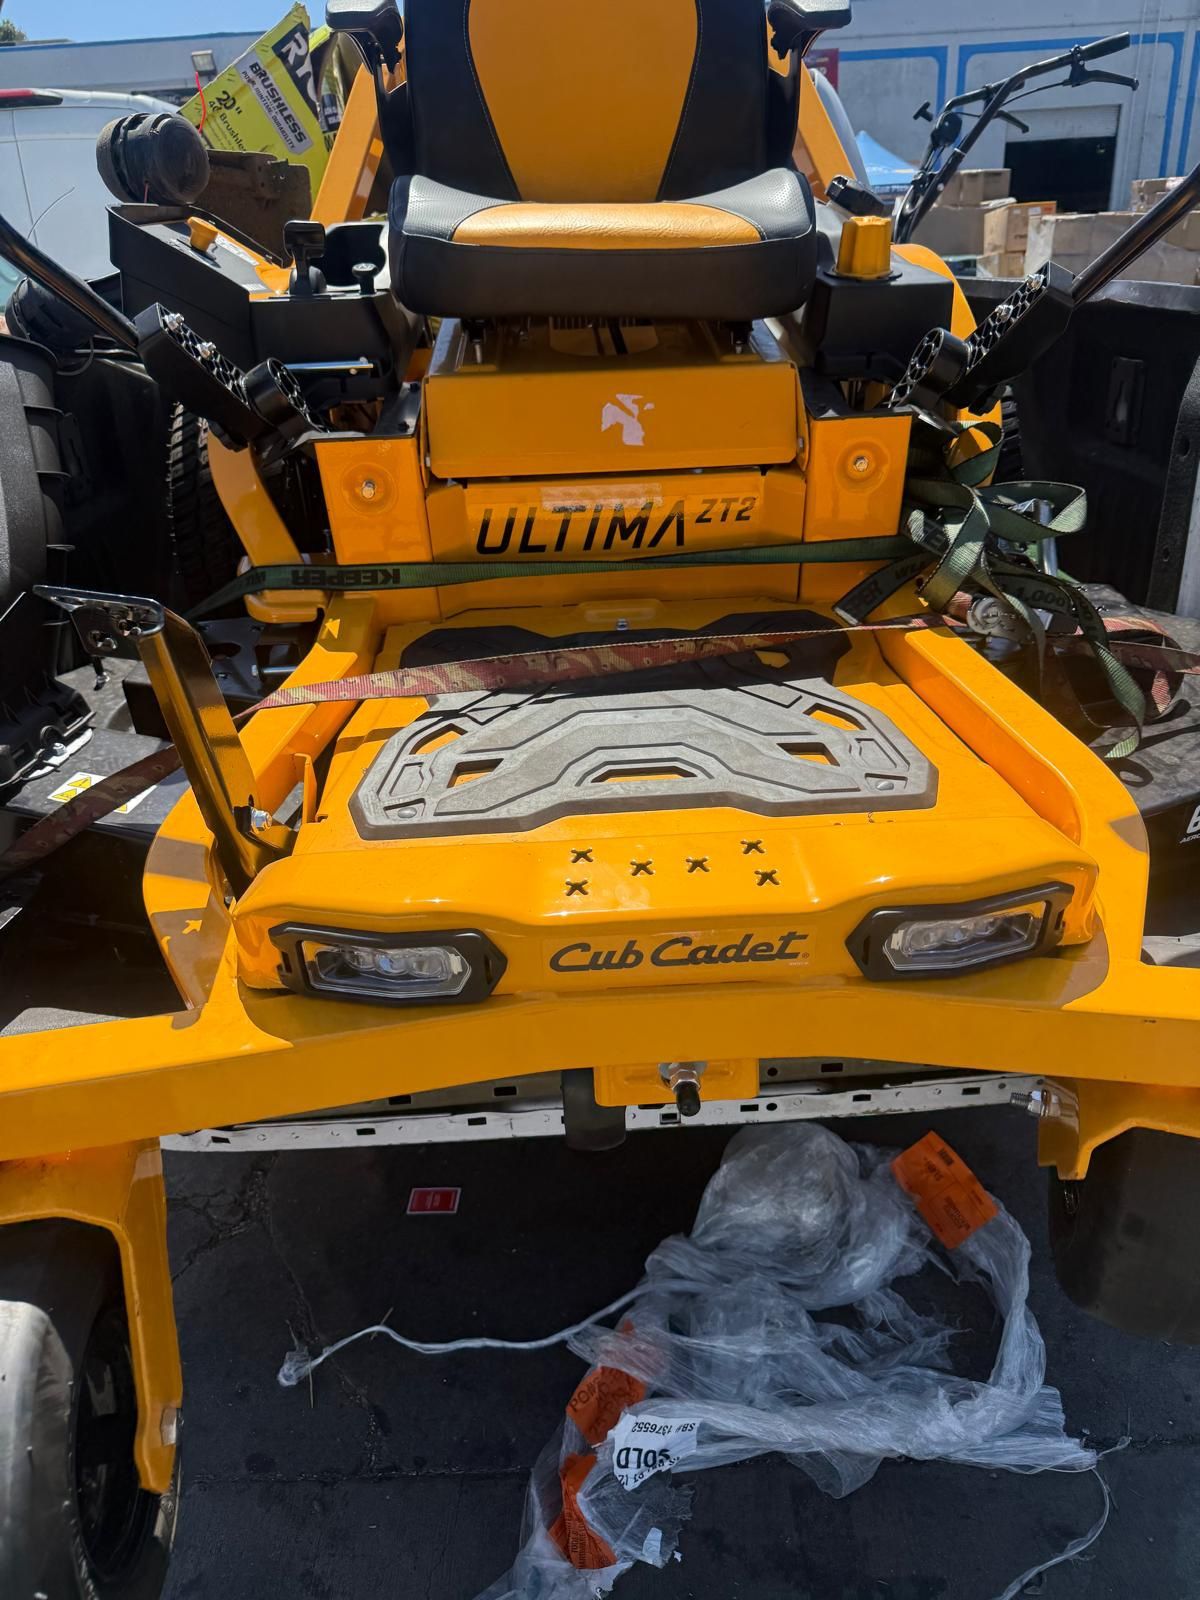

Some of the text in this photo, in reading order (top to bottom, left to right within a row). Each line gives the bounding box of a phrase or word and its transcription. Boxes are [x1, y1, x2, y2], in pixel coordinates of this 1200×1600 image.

[249, 62, 307, 143] BRUSHLESS
[475, 496, 756, 555] ULTIMA ZT2
[291, 568, 400, 585] KEEPER
[549, 939, 644, 972] Cub
[631, 1421, 696, 1436] SB# 1376552
[616, 1447, 671, 1469] SOLD
